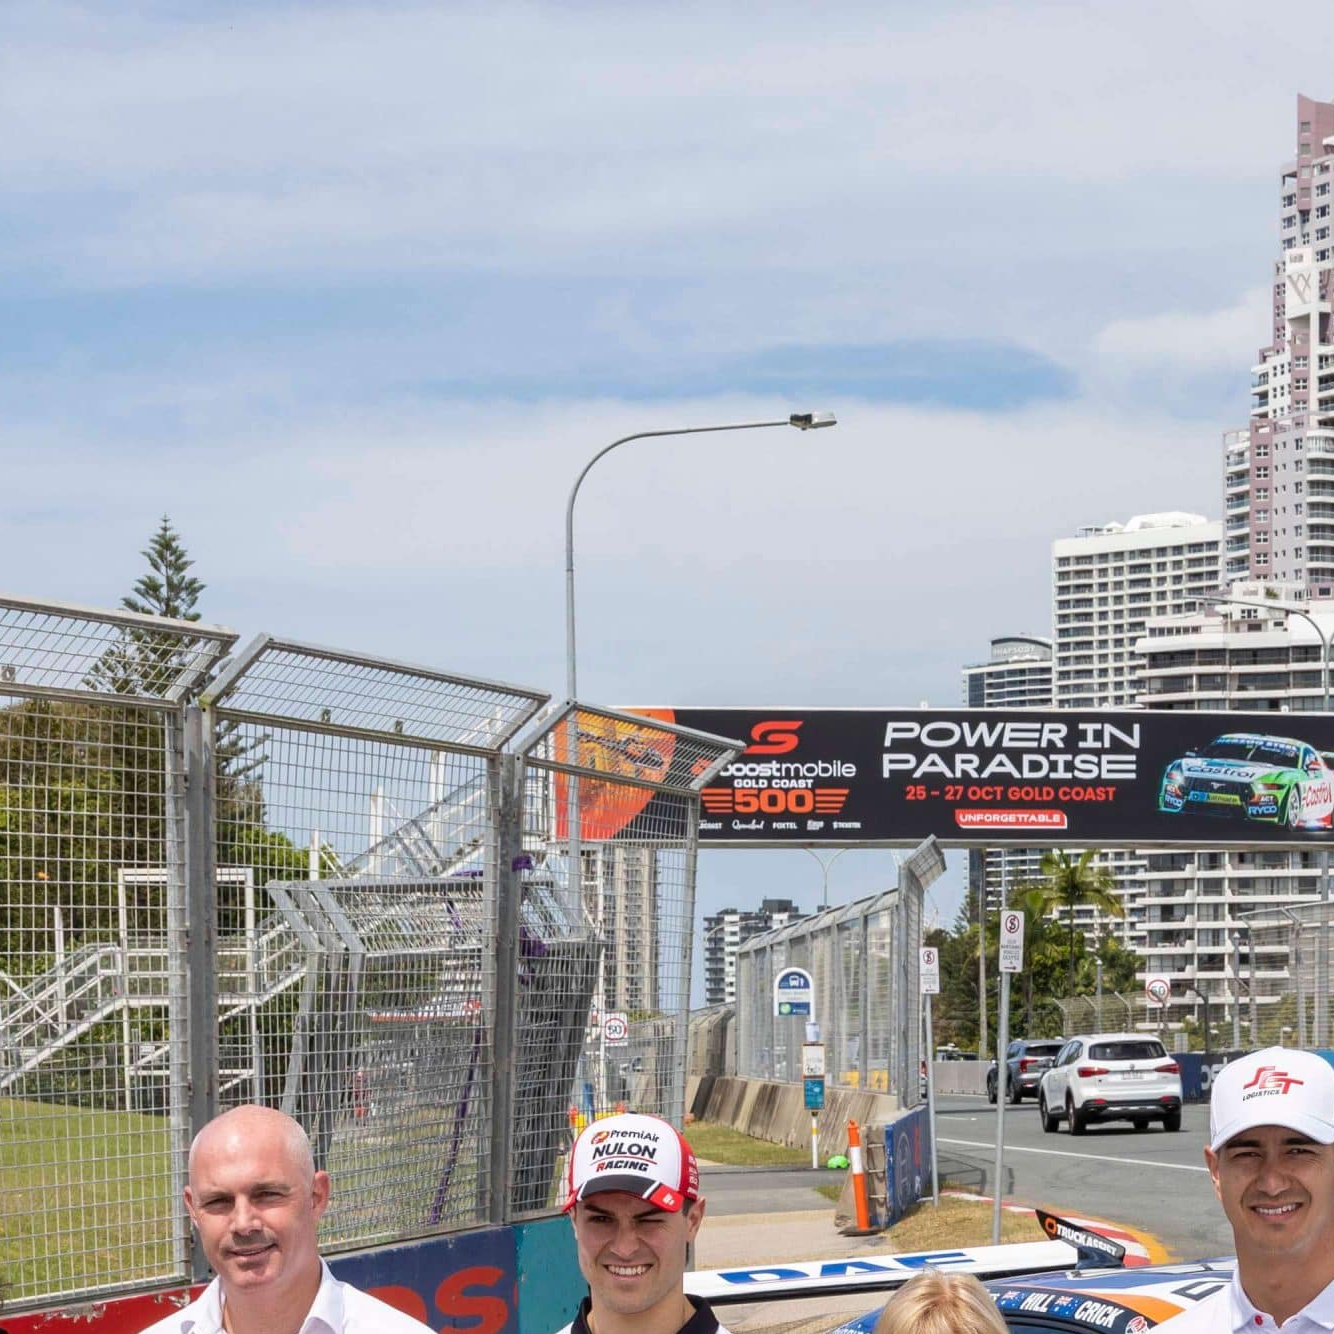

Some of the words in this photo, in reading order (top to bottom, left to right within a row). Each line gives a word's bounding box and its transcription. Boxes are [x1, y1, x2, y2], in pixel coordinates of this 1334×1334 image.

[884, 721, 1067, 748] POWER
[1078, 722, 1140, 749] IN
[882, 753, 1137, 779] PARADISE
[733, 778, 768, 788] GOLD
[771, 778, 814, 789] COAST
[733, 789, 815, 814] 500
[906, 785, 926, 800] 25
[944, 785, 964, 800] 27
[967, 786, 1004, 801] OCT
[1008, 786, 1055, 801] GOLD
[1058, 786, 1116, 802] COAST
[959, 813, 1061, 824] UNFORGETTABLE
[1242, 1089, 1281, 1102] LOGISTICS
[610, 1129, 660, 1143] PremiAir
[592, 1142, 657, 1160] NULON
[596, 1160, 650, 1173] RACING
[1019, 1291, 1056, 1313] HILL
[1074, 1300, 1124, 1329] CRICK
